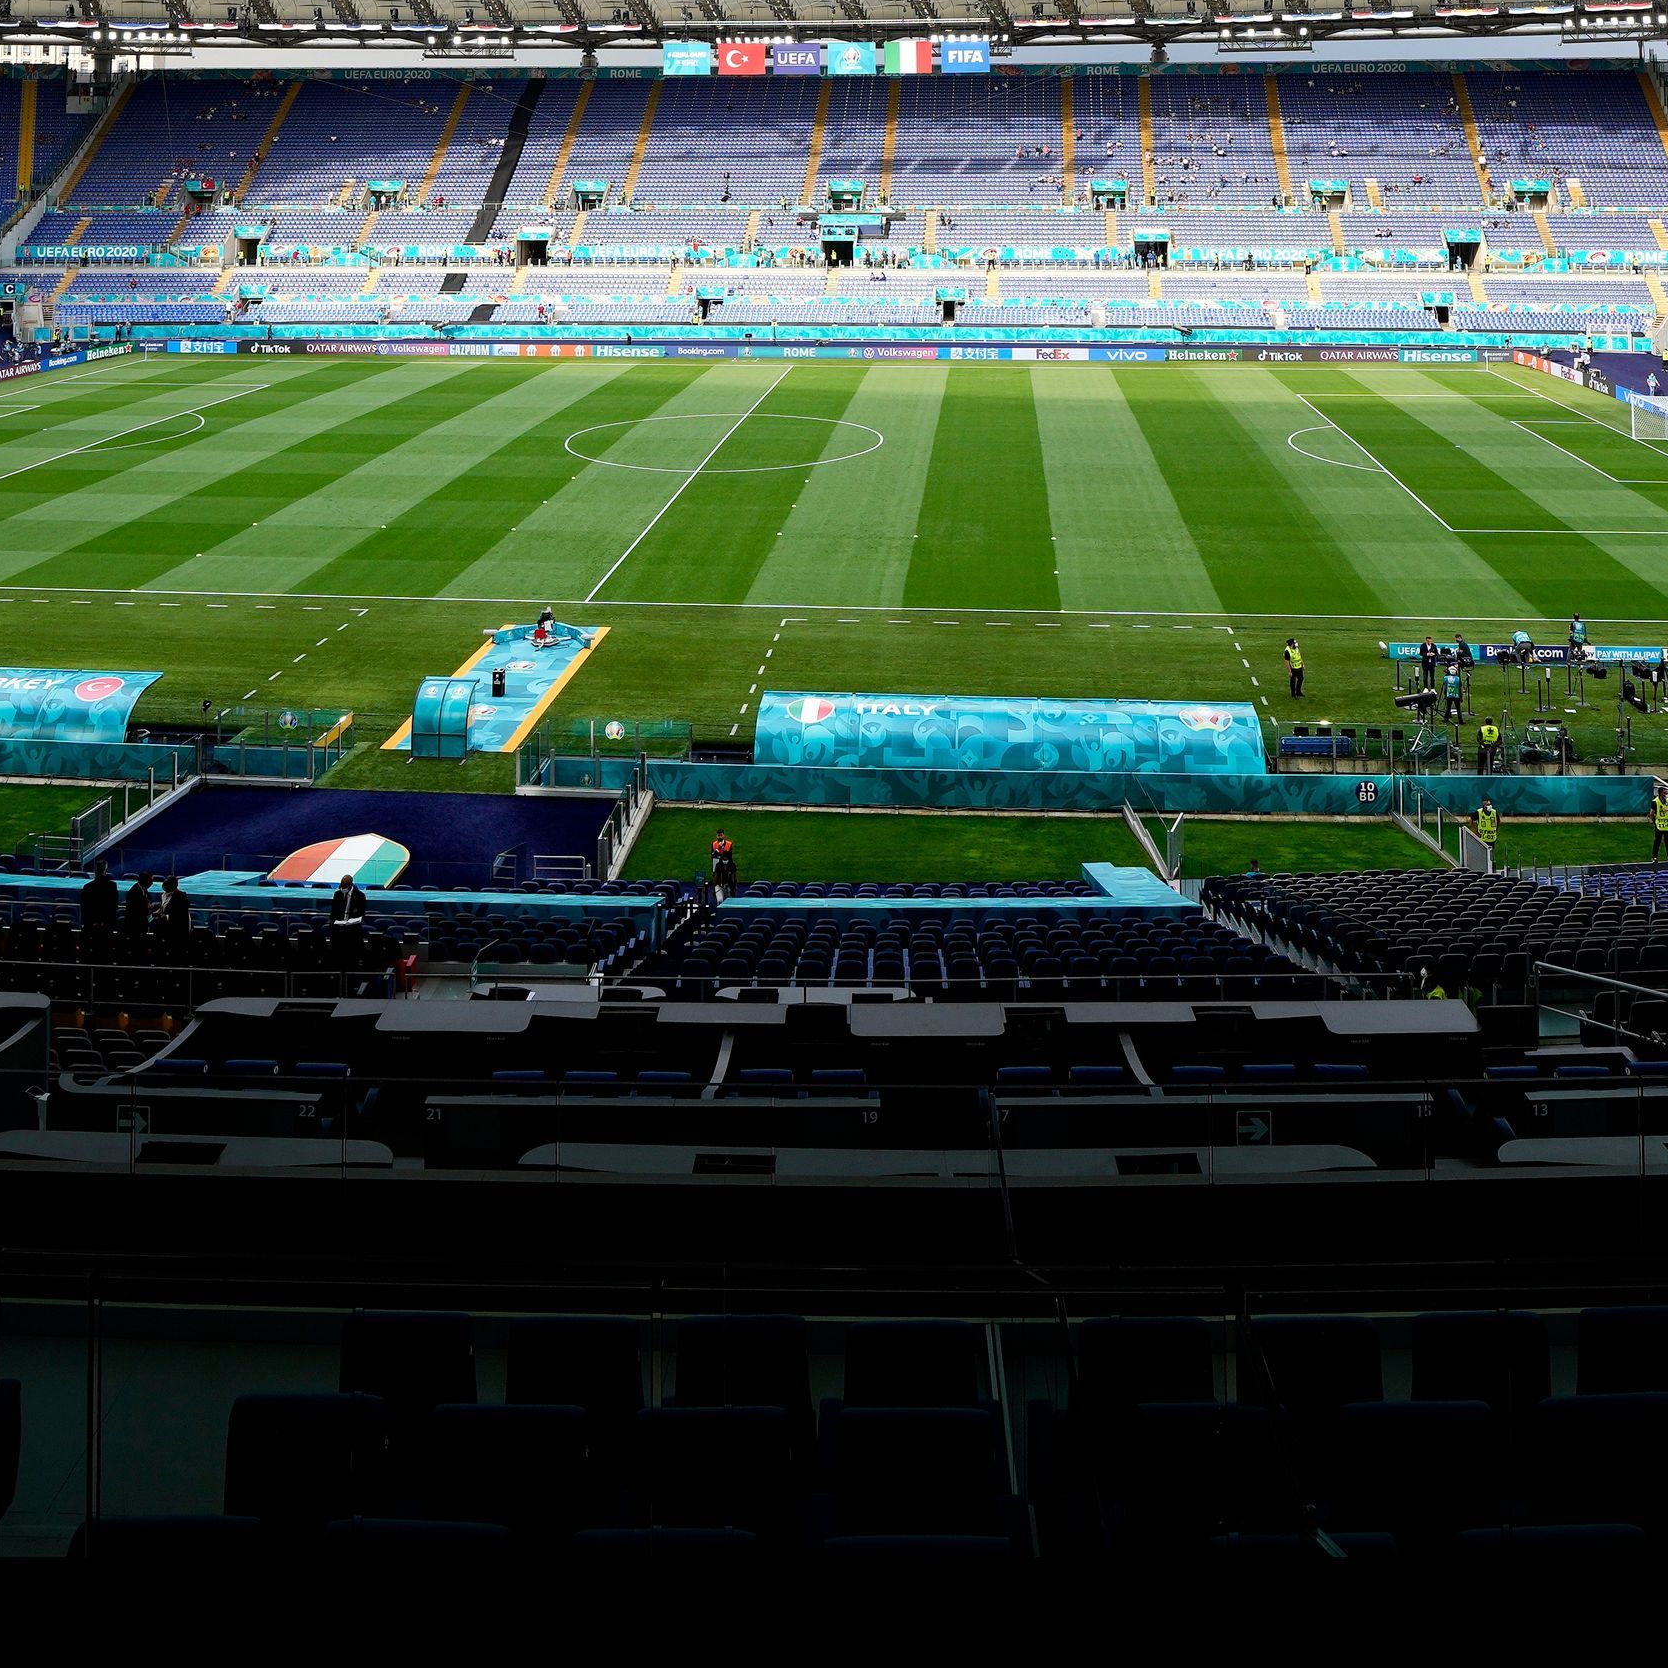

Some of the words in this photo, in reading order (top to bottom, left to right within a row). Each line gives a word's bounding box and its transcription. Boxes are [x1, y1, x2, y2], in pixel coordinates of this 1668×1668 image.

[777, 52, 816, 65] UEFA
[948, 50, 984, 63] FIFA
[610, 69, 642, 78] ROME
[1087, 66, 1120, 75] ROME
[1312, 64, 1342, 73] UEFA
[1344, 64, 1375, 73] EURO
[1377, 63, 1406, 72] 2020
[344, 70, 373, 80] UEFA
[374, 70, 403, 80] EURO
[404, 70, 431, 80] 2020
[37, 246, 70, 258] UEFA
[106, 246, 138, 258] 2020
[5, 284, 14, 294] C
[86, 345, 126, 361] Heineken
[260, 343, 291, 354] TikTok
[307, 343, 337, 352] QATAR
[338, 343, 378, 353] AIRWAYS
[392, 344, 444, 355] Volkswagen
[449, 345, 490, 356] GAZPROM
[596, 346, 660, 357] Hisense
[678, 347, 725, 357] Booking.com
[784, 348, 816, 358] ROME
[878, 348, 934, 359] Volkswagen
[1036, 349, 1070, 360] FedEx
[1106, 349, 1148, 360] vivo
[1169, 349, 1227, 360] Heineken
[1270, 352, 1303, 362] TikTok
[1320, 350, 1353, 360] QATAR
[1356, 350, 1398, 361] AIRWAYS
[1404, 350, 1472, 362] Hisense
[48, 354, 78, 368] Booking.com
[14, 362, 42, 377] AIRWAYS
[1560, 366, 1576, 382] FedEx
[1593, 380, 1610, 394] TikTok
[1624, 390, 1644, 408] vvo
[856, 702, 936, 716] ITALY
[1360, 782, 1374, 791] 10
[1359, 792, 1375, 802] BD
[298, 1105, 316, 1117] 22
[426, 1108, 440, 1120] 21
[1532, 1104, 1548, 1116] 13
[862, 1111, 878, 1124] 19
